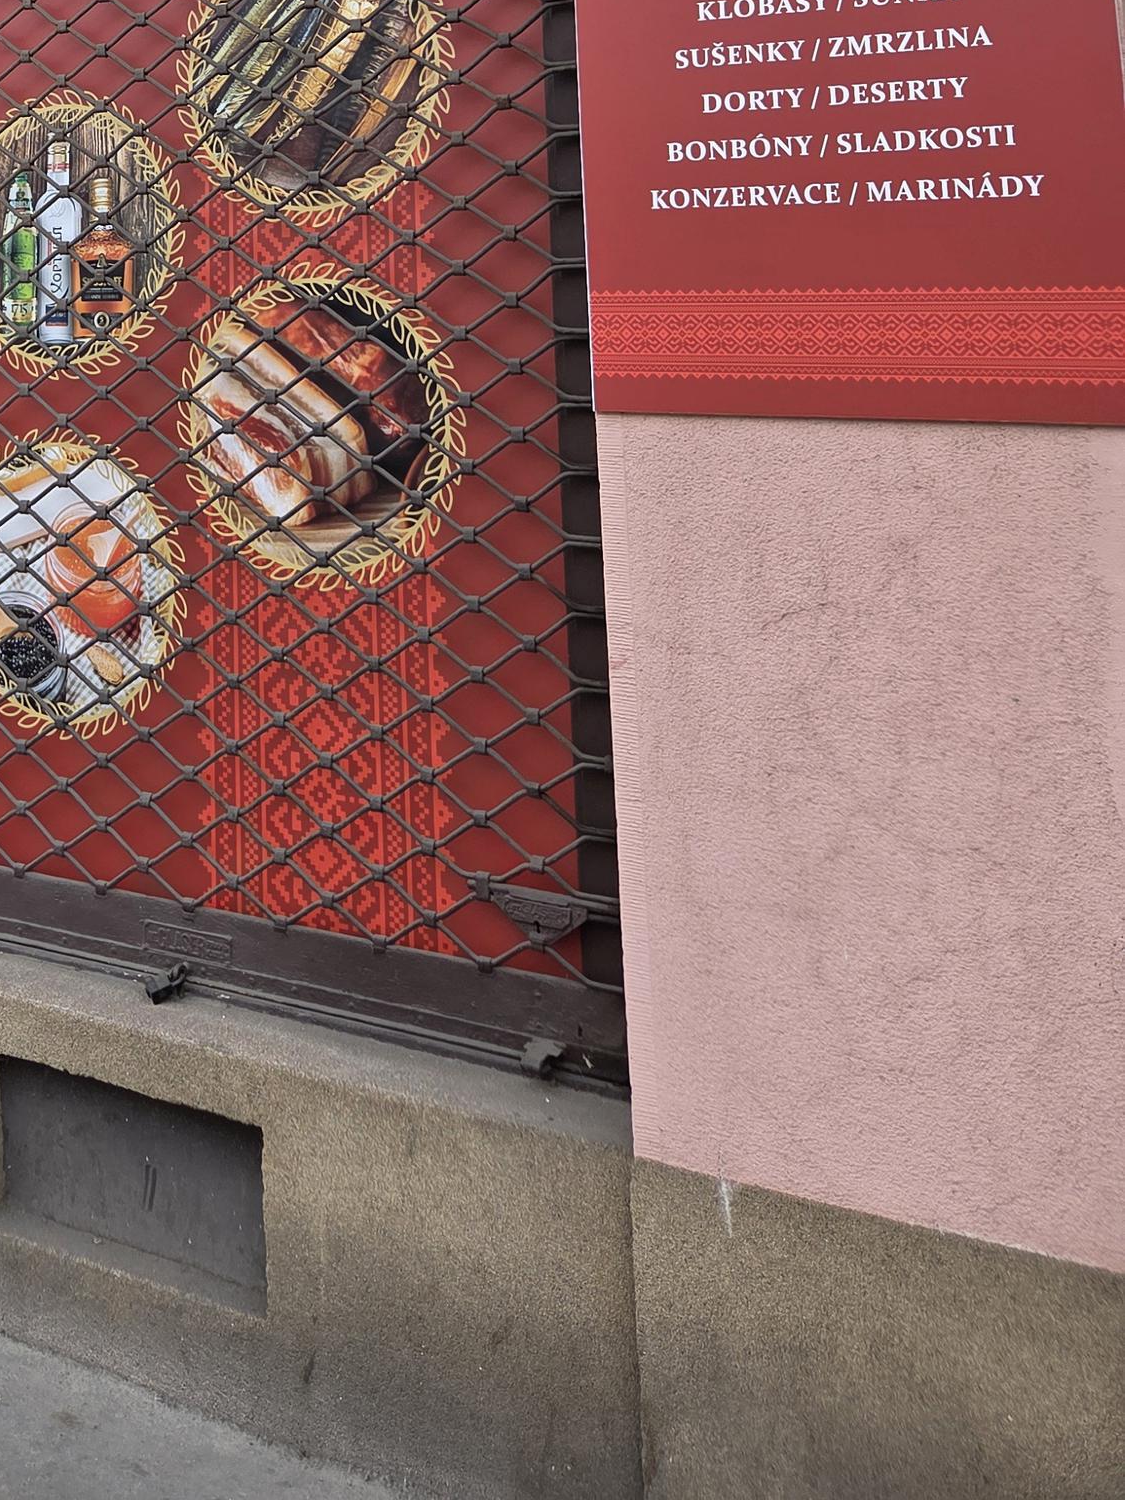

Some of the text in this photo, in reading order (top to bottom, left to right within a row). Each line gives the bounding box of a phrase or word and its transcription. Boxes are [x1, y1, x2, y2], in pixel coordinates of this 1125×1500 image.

[675, 40, 805, 69] SUŠENKY
[828, 25, 993, 58] ZMRZLINA
[701, 87, 804, 114] DORTY
[827, 76, 968, 106] DESERTY
[666, 133, 813, 162] BONBÓNY
[836, 124, 1016, 155] SLADKOSTI
[650, 183, 841, 210] KONZERVACE
[866, 172, 1044, 202] MARINÁDY
